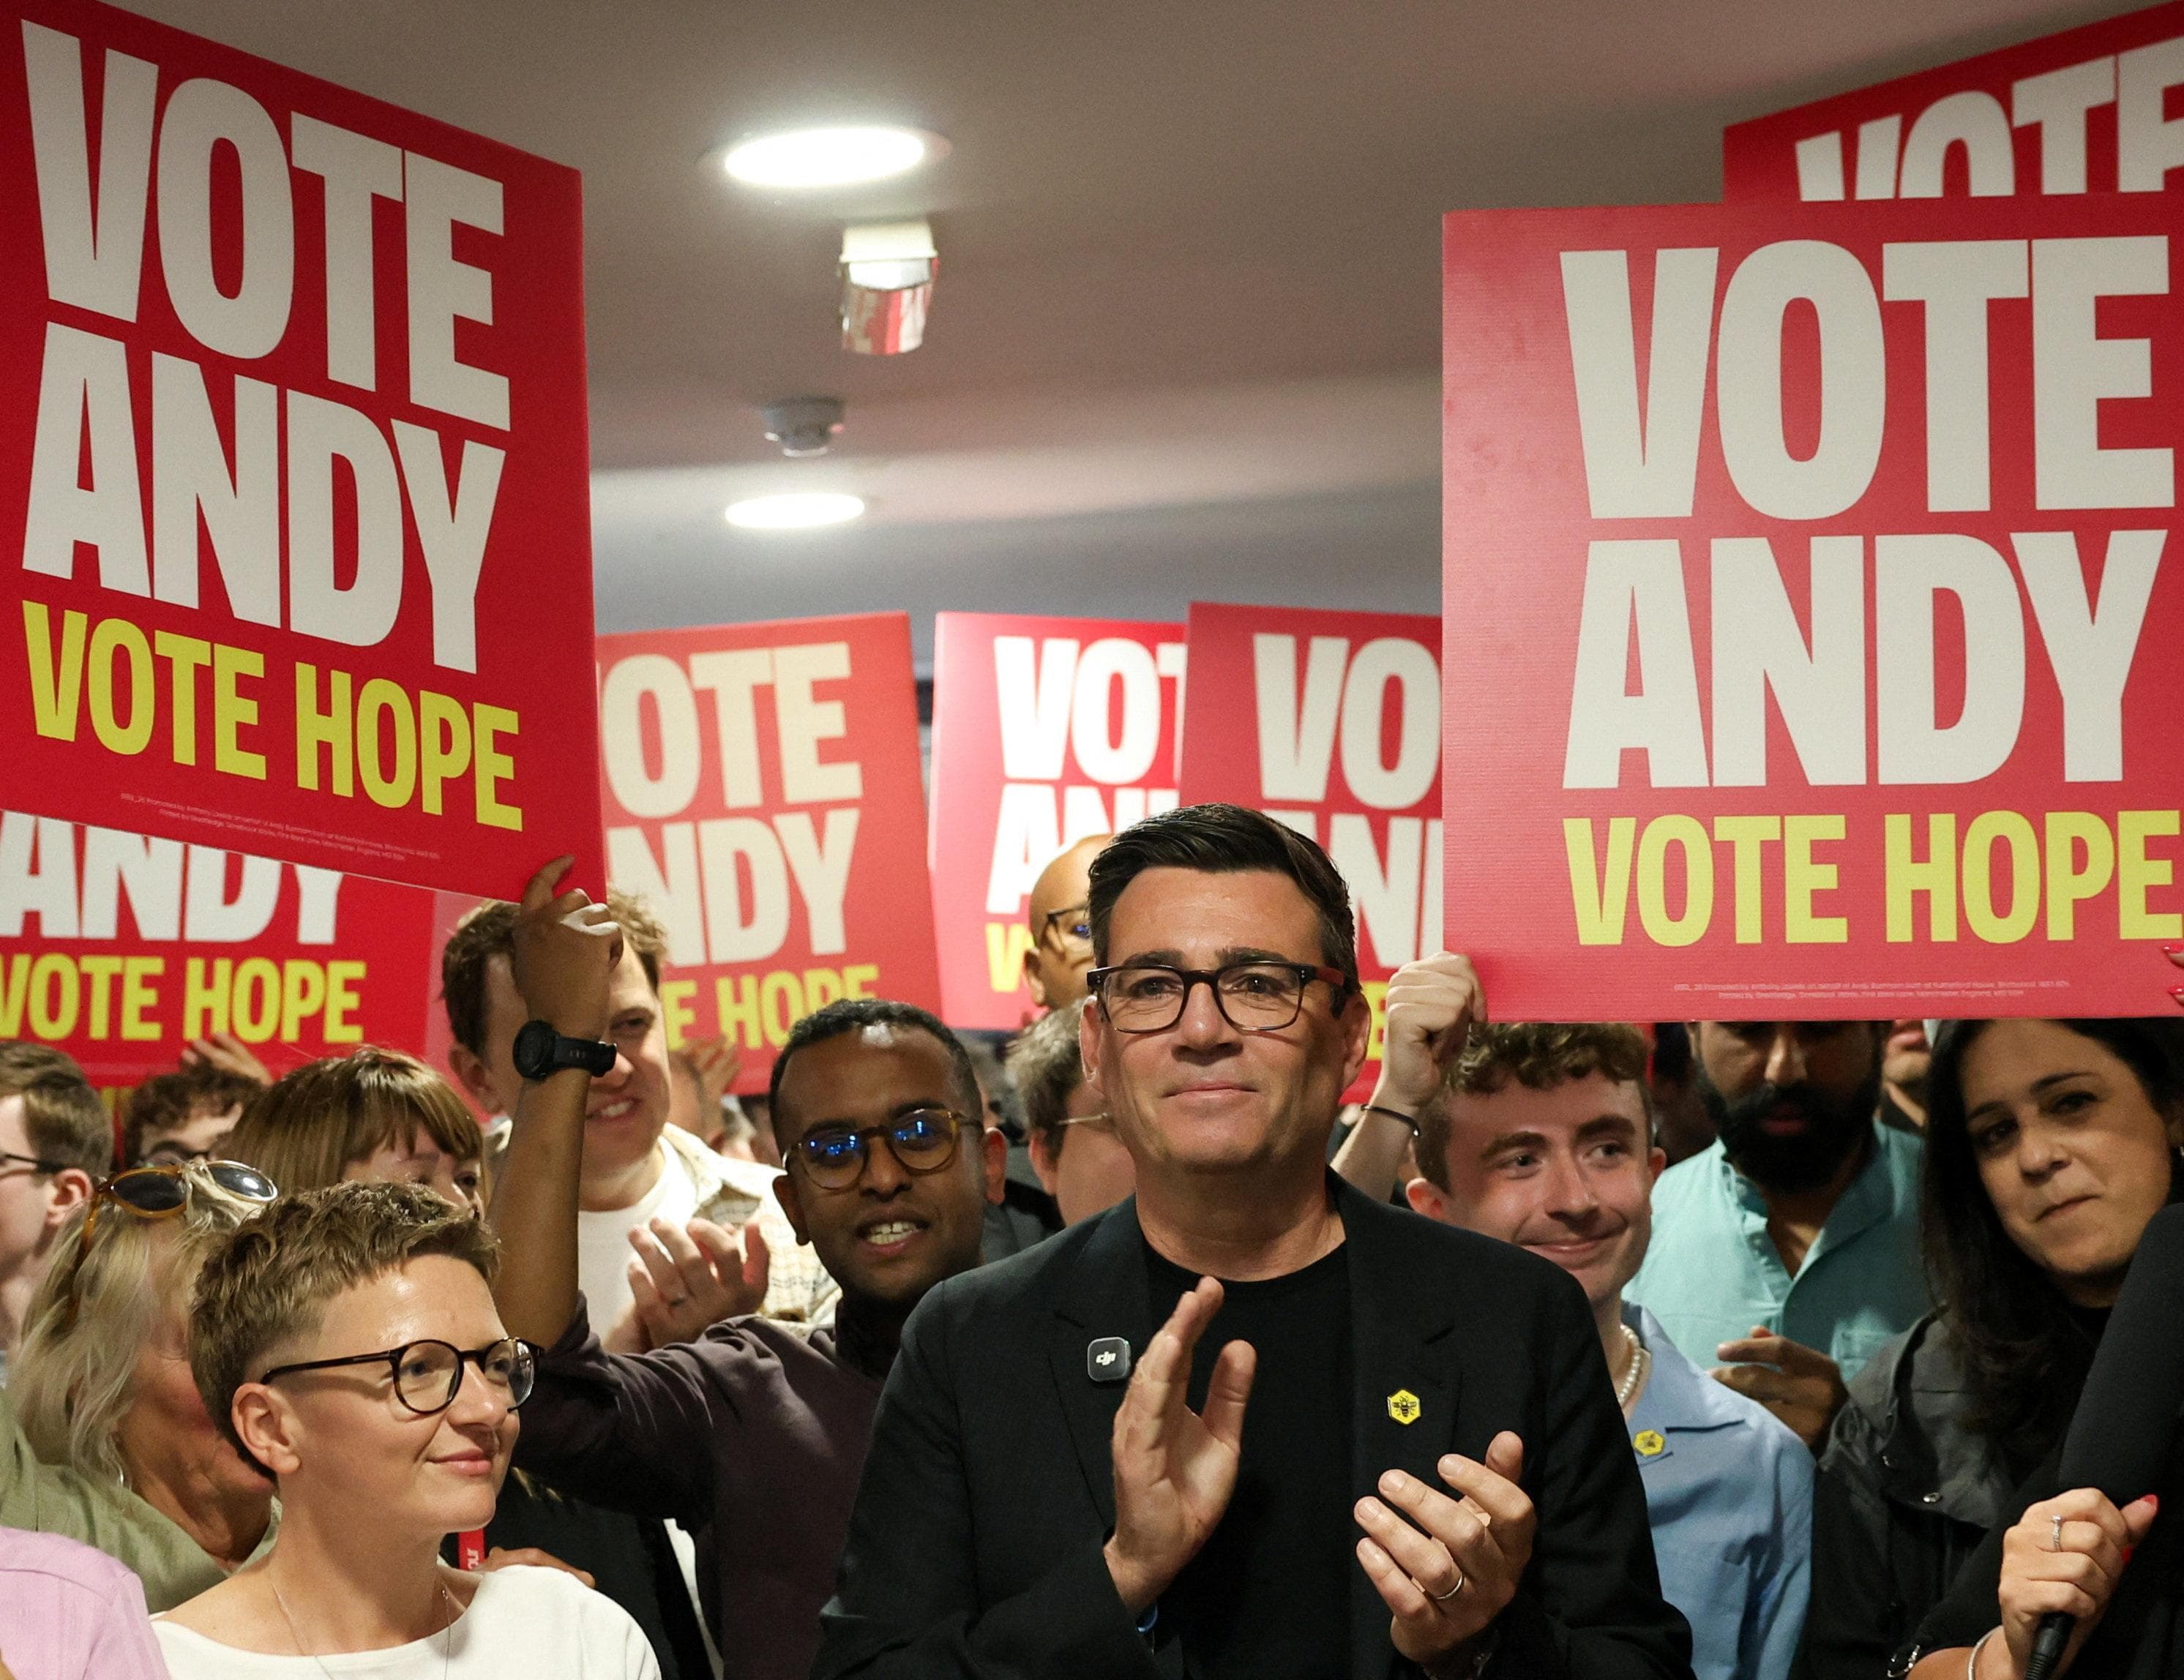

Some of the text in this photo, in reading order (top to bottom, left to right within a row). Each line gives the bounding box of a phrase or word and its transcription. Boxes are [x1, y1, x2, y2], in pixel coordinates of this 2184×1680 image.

[21, 19, 511, 432] VOTE
[1560, 235, 2175, 520] VOTE
[22, 320, 506, 674] ANDY
[22, 600, 523, 832] VOTE HOPE
[599, 642, 863, 818] OTE
[993, 636, 1188, 784] VO
[1254, 633, 1443, 809] VO
[1563, 529, 2168, 789] ANDY
[606, 808, 861, 967] NDY
[1563, 814, 1848, 946] VOTE
[1885, 809, 2183, 943] HOPE
[0, 953, 366, 1043] VOTE HOPE
